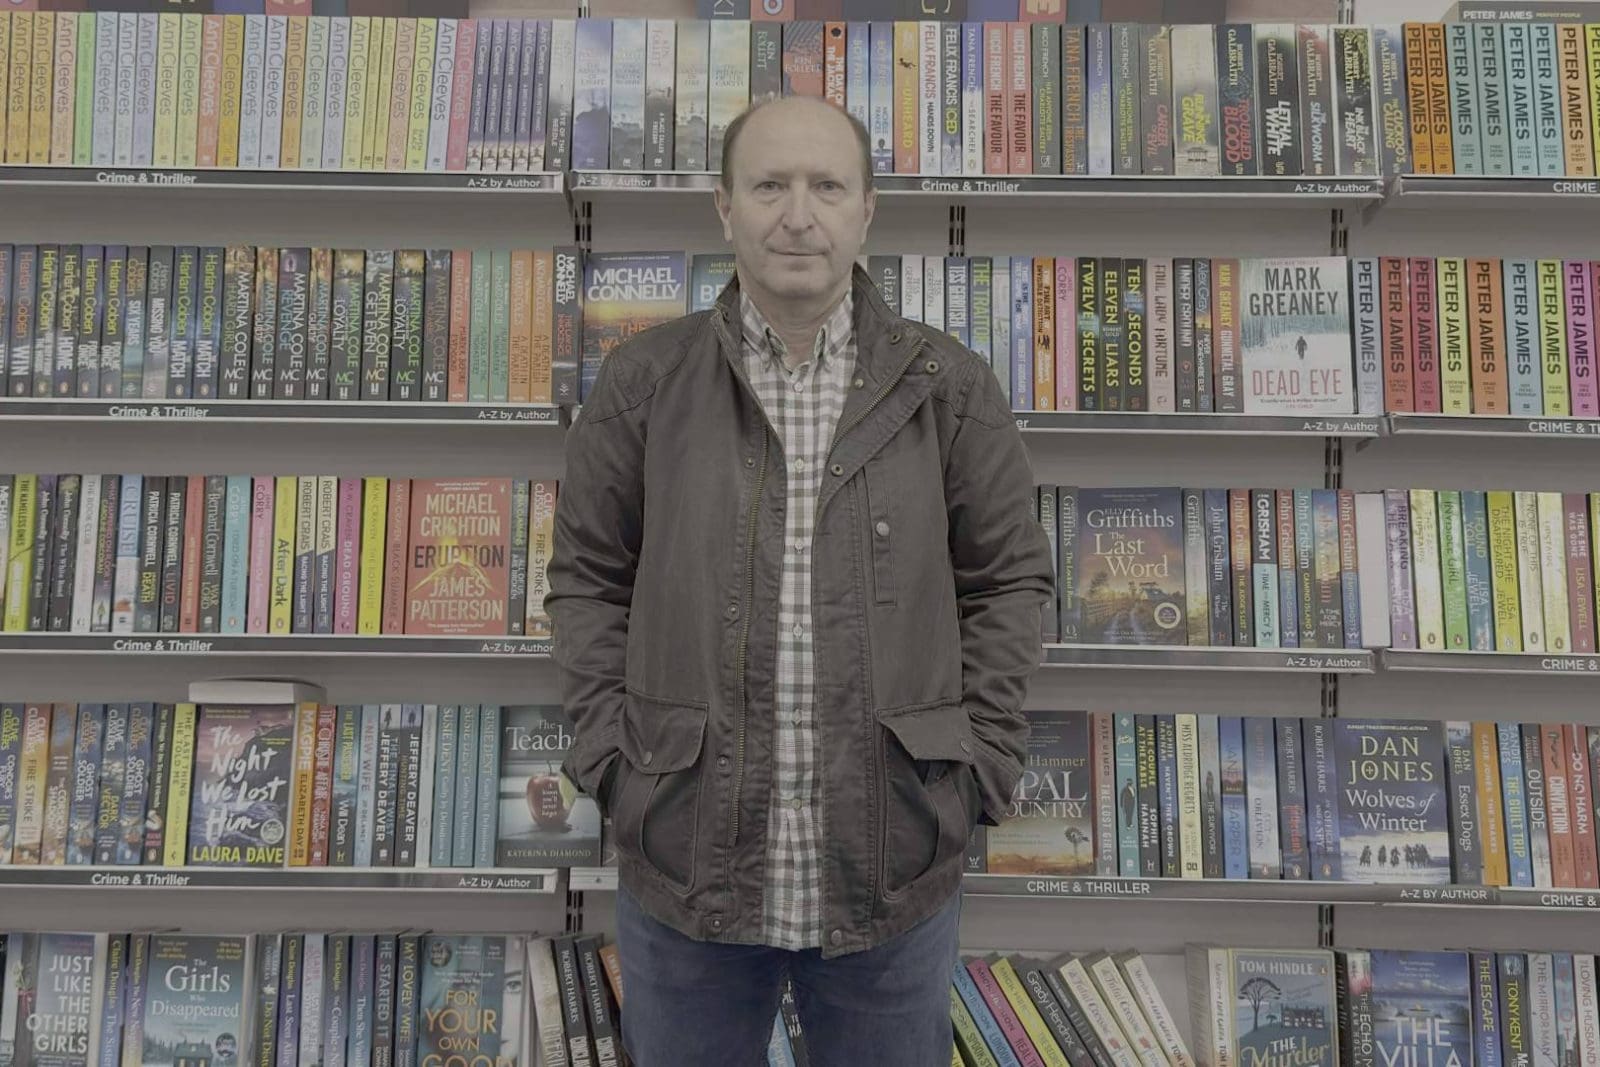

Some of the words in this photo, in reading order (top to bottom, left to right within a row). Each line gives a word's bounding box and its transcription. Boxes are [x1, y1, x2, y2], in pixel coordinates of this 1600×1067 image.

[1463, 11, 1496, 19] PETER
[1499, 11, 1533, 20] JAMES
[925, 25, 936, 51] FELIX
[1452, 25, 1468, 77] PETER
[1563, 28, 1579, 80] PETER
[925, 54, 936, 98] FRANCIS
[991, 94, 1002, 113] THE
[1456, 81, 1472, 135] JAMES
[1567, 85, 1583, 140] JAMES
[991, 114, 1002, 153] FAVOUR
[1265, 108, 1281, 155] WHITE
[1278, 101, 1291, 149] LETHAL
[97, 172, 137, 184] Crime
[138, 173, 148, 183] &
[152, 172, 196, 184] Thriller
[468, 178, 488, 187] A-Z
[490, 178, 502, 188] by
[506, 178, 540, 188] Author
[579, 176, 599, 186] A-Z
[601, 177, 614, 187] by
[616, 177, 652, 186] Author
[921, 180, 959, 192] Crime
[962, 182, 972, 192] &
[975, 181, 1020, 192] Thriller
[1295, 183, 1316, 192] A-Z
[1318, 183, 1332, 193] by
[1334, 183, 1370, 193] Author
[1553, 182, 1597, 193] CRIME
[85, 258, 98, 295] Harlan
[594, 267, 677, 284] MICHAEL
[1128, 266, 1140, 295] TEN
[1265, 267, 1321, 291] MARK
[1444, 260, 1459, 313] PETER
[588, 283, 681, 301] CONNELLY
[1081, 262, 1094, 319] TWELVE
[1104, 270, 1118, 324] ELEVEN
[1250, 291, 1338, 316] GREANEY
[83, 297, 97, 334] Coben
[394, 299, 406, 350] LOYALTY
[1128, 315, 1141, 386] SECONDS
[1446, 317, 1461, 372] JAMES
[1082, 332, 1095, 392] SECRETS
[1105, 344, 1119, 388] LIARS
[1253, 370, 1301, 396] DEAD
[1310, 369, 1343, 395] EYE
[109, 406, 149, 417] Crime
[151, 407, 160, 417] &
[164, 406, 209, 417] Thriller
[479, 410, 498, 419] A-Z
[501, 410, 513, 420] by
[516, 410, 551, 420] Author
[1304, 422, 1322, 431] A-Z
[1326, 422, 1340, 432] by
[1343, 422, 1379, 431] Author
[1528, 421, 1572, 432] CRIME
[1576, 423, 1585, 433] &
[322, 481, 332, 517] ROBERT
[426, 492, 497, 514] MICHAEL
[420, 516, 500, 536] CRICHTON
[1087, 508, 1175, 528] Griffiths
[1258, 498, 1271, 561] GRISHAM
[321, 520, 331, 549] CRAIS
[1094, 533, 1145, 555] Last
[1110, 531, 1124, 540] The
[277, 539, 290, 573] After
[414, 545, 504, 568] ERUPTION
[1105, 555, 1168, 578] Word
[275, 576, 287, 606] Dark
[429, 576, 485, 598] JAMES
[411, 600, 502, 621] PATTERSON
[114, 640, 151, 651] Crime
[154, 641, 164, 651] &
[168, 640, 212, 651] Thriller
[482, 643, 501, 652] A-Z
[504, 643, 516, 653] by
[519, 644, 553, 652] Author
[1287, 657, 1307, 667] A-Z
[1309, 658, 1322, 668] by
[1325, 658, 1361, 668] Author
[1542, 659, 1585, 670] CRIME
[1589, 660, 1598, 670] &
[538, 720, 556, 729] The
[211, 725, 246, 749] The
[1361, 735, 1420, 757] DAN
[211, 744, 278, 783] Night
[379, 733, 390, 787] JEFFERY
[1030, 754, 1085, 767] Hammer
[1348, 760, 1434, 785] JONES
[200, 780, 234, 802] We
[237, 780, 286, 805] Lost
[1345, 788, 1415, 810] Wolves
[1419, 792, 1436, 816] of
[1458, 785, 1471, 818] Essex
[1527, 769, 1544, 829] OUTSIDE
[375, 790, 387, 842] DEAVER
[1141, 803, 1149, 848] HANNAH
[1149, 808, 1157, 844] SOPHIE
[1359, 812, 1427, 833] Winter
[206, 810, 260, 846] Him
[1459, 821, 1473, 851] Dogs
[192, 846, 240, 862] LAURA
[246, 846, 284, 864] DAVE
[507, 850, 548, 858] KATERINA
[550, 850, 591, 858] DIAMOND
[92, 874, 129, 886] Crime
[132, 874, 142, 885] &
[145, 874, 190, 886] Thriller
[459, 878, 478, 887] A-Z
[481, 878, 494, 888] by
[496, 878, 531, 888] Author
[1027, 881, 1069, 893] CRIME
[1073, 882, 1082, 892] &
[1087, 882, 1150, 894] THRILLER
[1400, 889, 1421, 898] A-Z
[1424, 889, 1438, 898] BY
[1441, 889, 1487, 900] AUTHOR
[1541, 894, 1584, 906] CRIME
[1588, 896, 1597, 906] &
[380, 941, 392, 959] HE
[50, 955, 93, 973] JUST
[193, 959, 207, 967] The
[1240, 960, 1266, 973] TOM
[1270, 961, 1313, 975] HINDLE
[1479, 958, 1491, 982] THE
[54, 976, 91, 994] LIKE
[165, 965, 231, 993] Girls
[377, 964, 391, 1021] STARTED
[447, 990, 477, 1006] FOR
[1506, 980, 1519, 1015] TONY
[59, 996, 90, 1014] THE
[152, 1000, 239, 1020] Disappeared
[1481, 984, 1494, 1032] ESCAPE
[27, 1014, 88, 1033] OTHER
[377, 1026, 388, 1038] IT
[425, 1008, 496, 1033] YOUR
[1388, 1016, 1451, 1046] THE
[35, 1035, 88, 1054] GIRLS
[439, 1037, 480, 1050] OWN
[1270, 1036, 1297, 1053] THE
[1508, 1017, 1521, 1051] KENT
[1241, 1036, 1330, 1067] Murder
